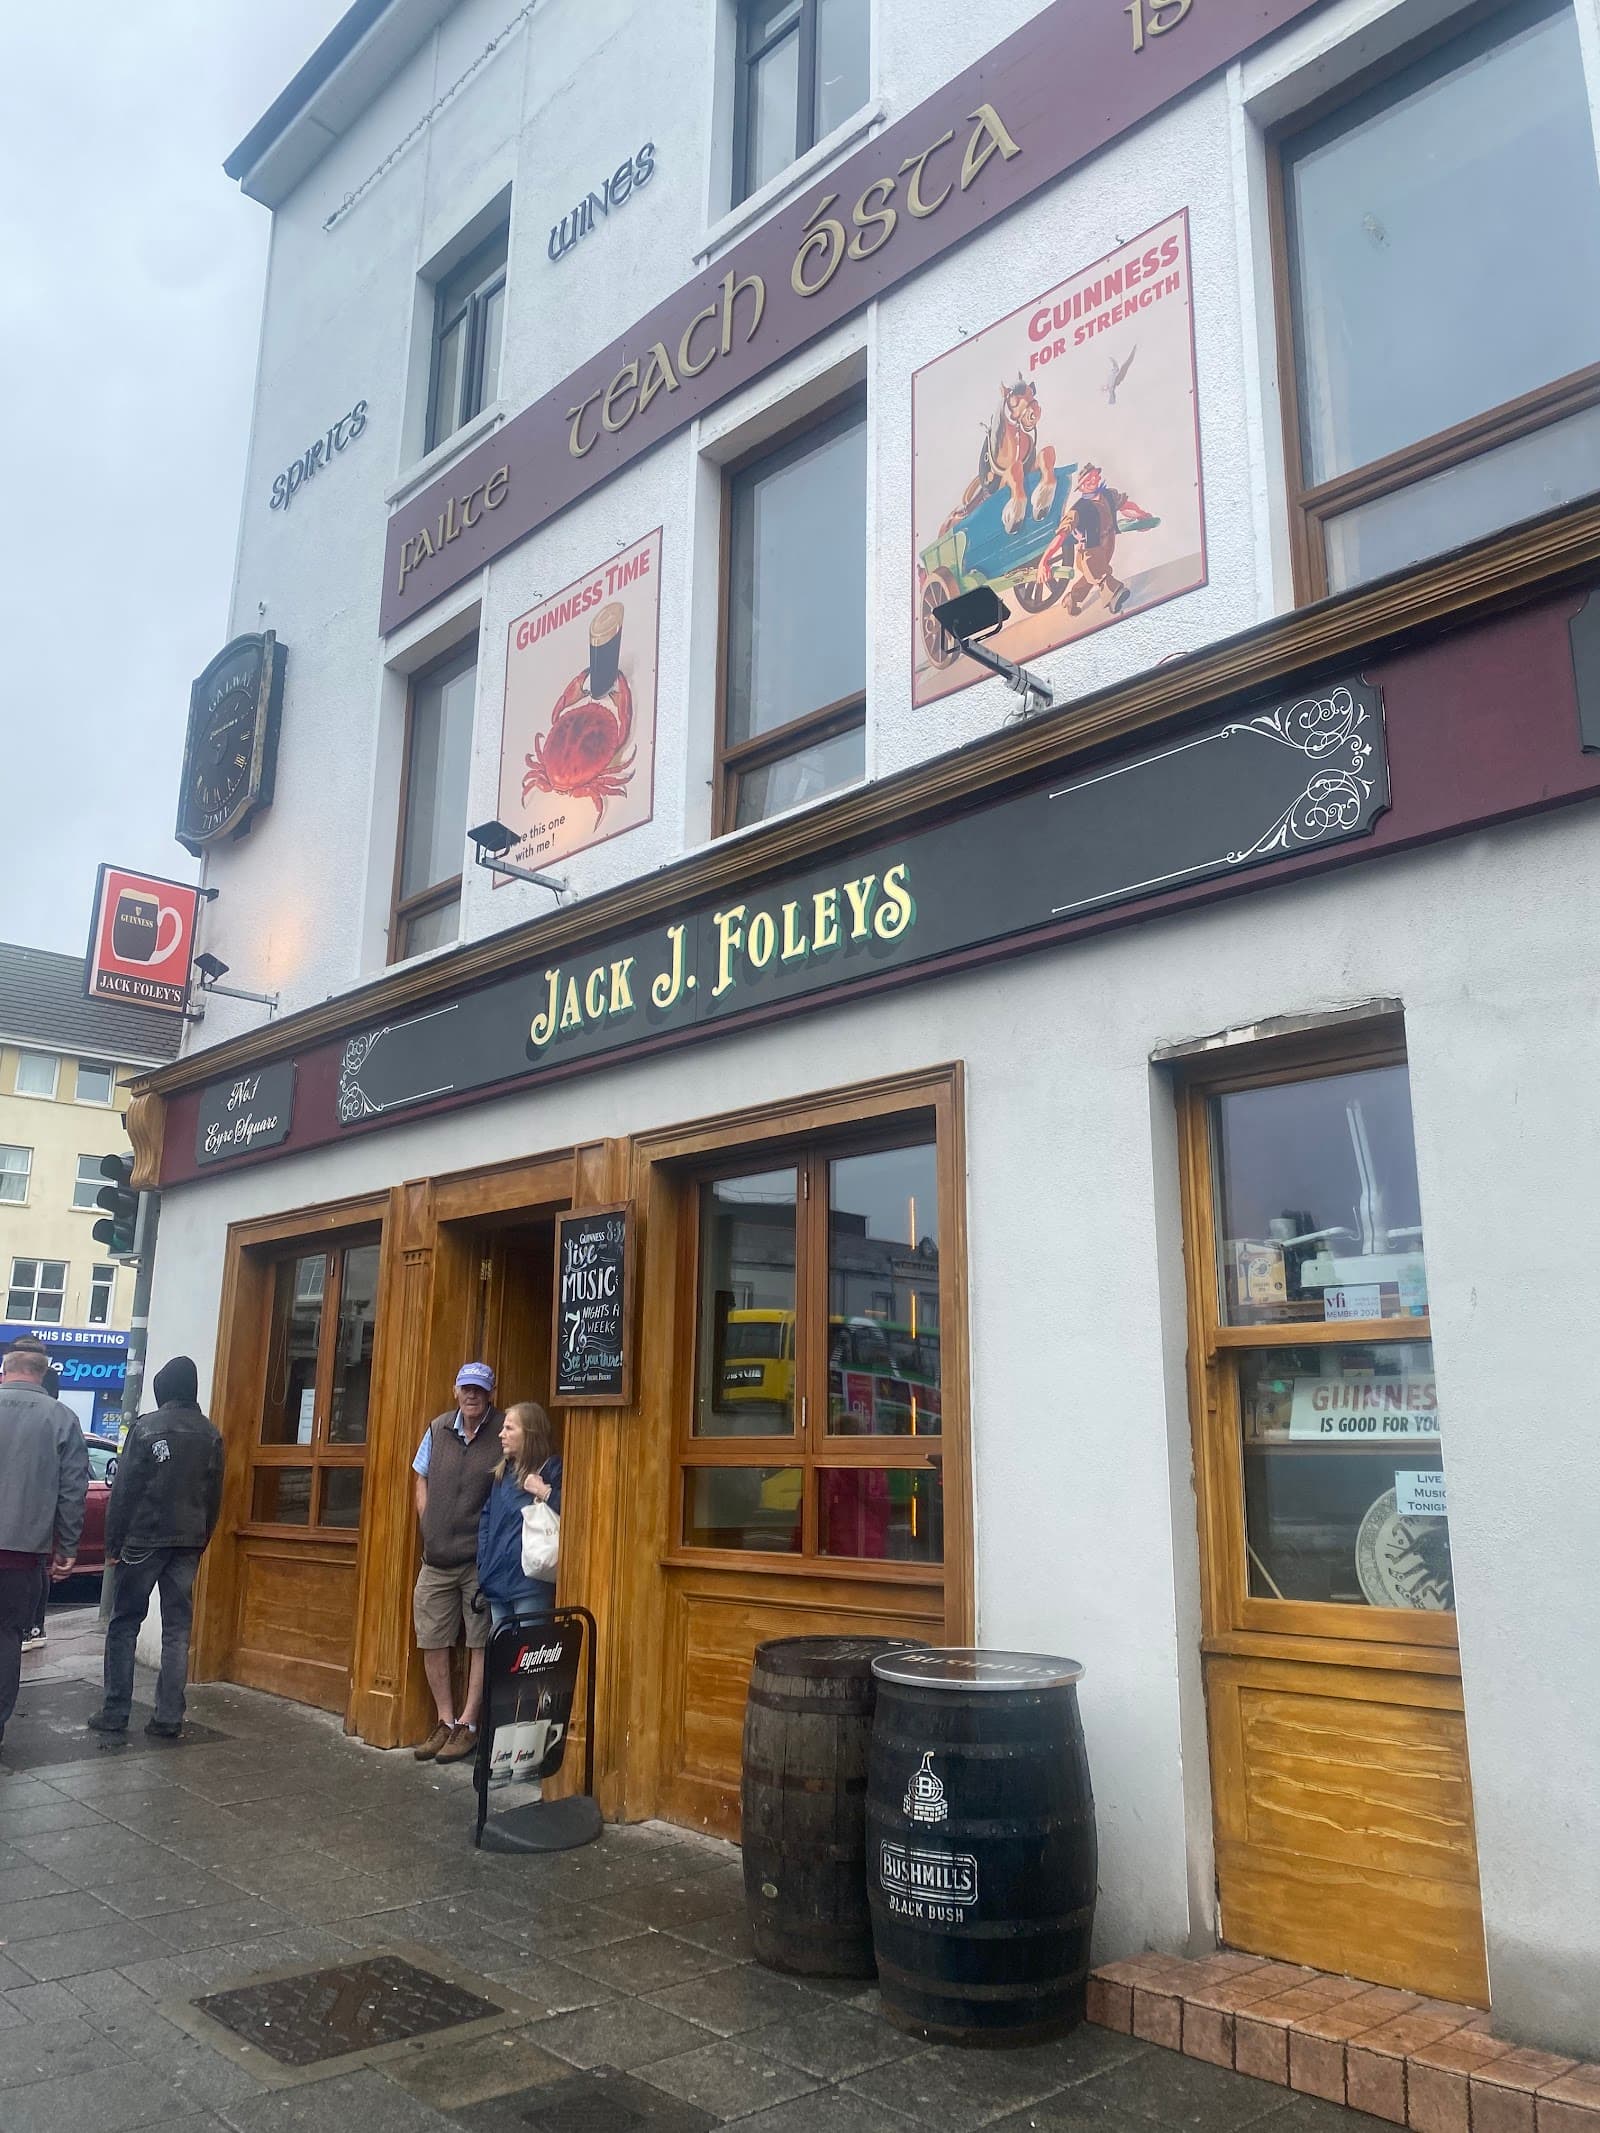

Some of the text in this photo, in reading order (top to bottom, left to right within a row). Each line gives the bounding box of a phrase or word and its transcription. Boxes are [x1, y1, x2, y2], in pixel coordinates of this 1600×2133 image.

[547, 140, 656, 262] WINES
[1027, 235, 1180, 342] GUINNESS
[1029, 272, 1181, 371] FOR STRENGTH
[565, 269, 767, 458] TEACH
[270, 400, 367, 510] SPIRITS
[516, 549, 650, 650] GUINNESS TIME
[529, 822, 545, 840] this
[549, 815, 565, 830] one
[515, 844, 534, 862] with
[120, 914, 154, 928] GUINNESS
[530, 864, 917, 1048] JACK J. FOLEYS
[100, 975, 182, 1002] JACK FOLEY'S
[205, 1113, 278, 1154] Eyre Square
[562, 1266, 616, 1303] MUSIC
[564, 1303, 620, 1352] 7 NIGHTS A
[587, 1320, 610, 1334] WEEK
[1360, 1309, 1379, 1318] 2024
[31, 1330, 125, 1345] THIS IS BETTING
[1312, 1383, 1438, 1411] GUINNES
[1321, 1417, 1333, 1433] IS
[1339, 1416, 1376, 1433] GOOD
[1383, 1416, 1408, 1433] FOR
[511, 1641, 562, 1673] Segafredo
[901, 1654, 1062, 1676] BUSHMILLS
[919, 1777, 933, 1798] B
[883, 1854, 972, 1891] BUSHMILLS
[889, 1895, 964, 1923] BLACK BUSH
